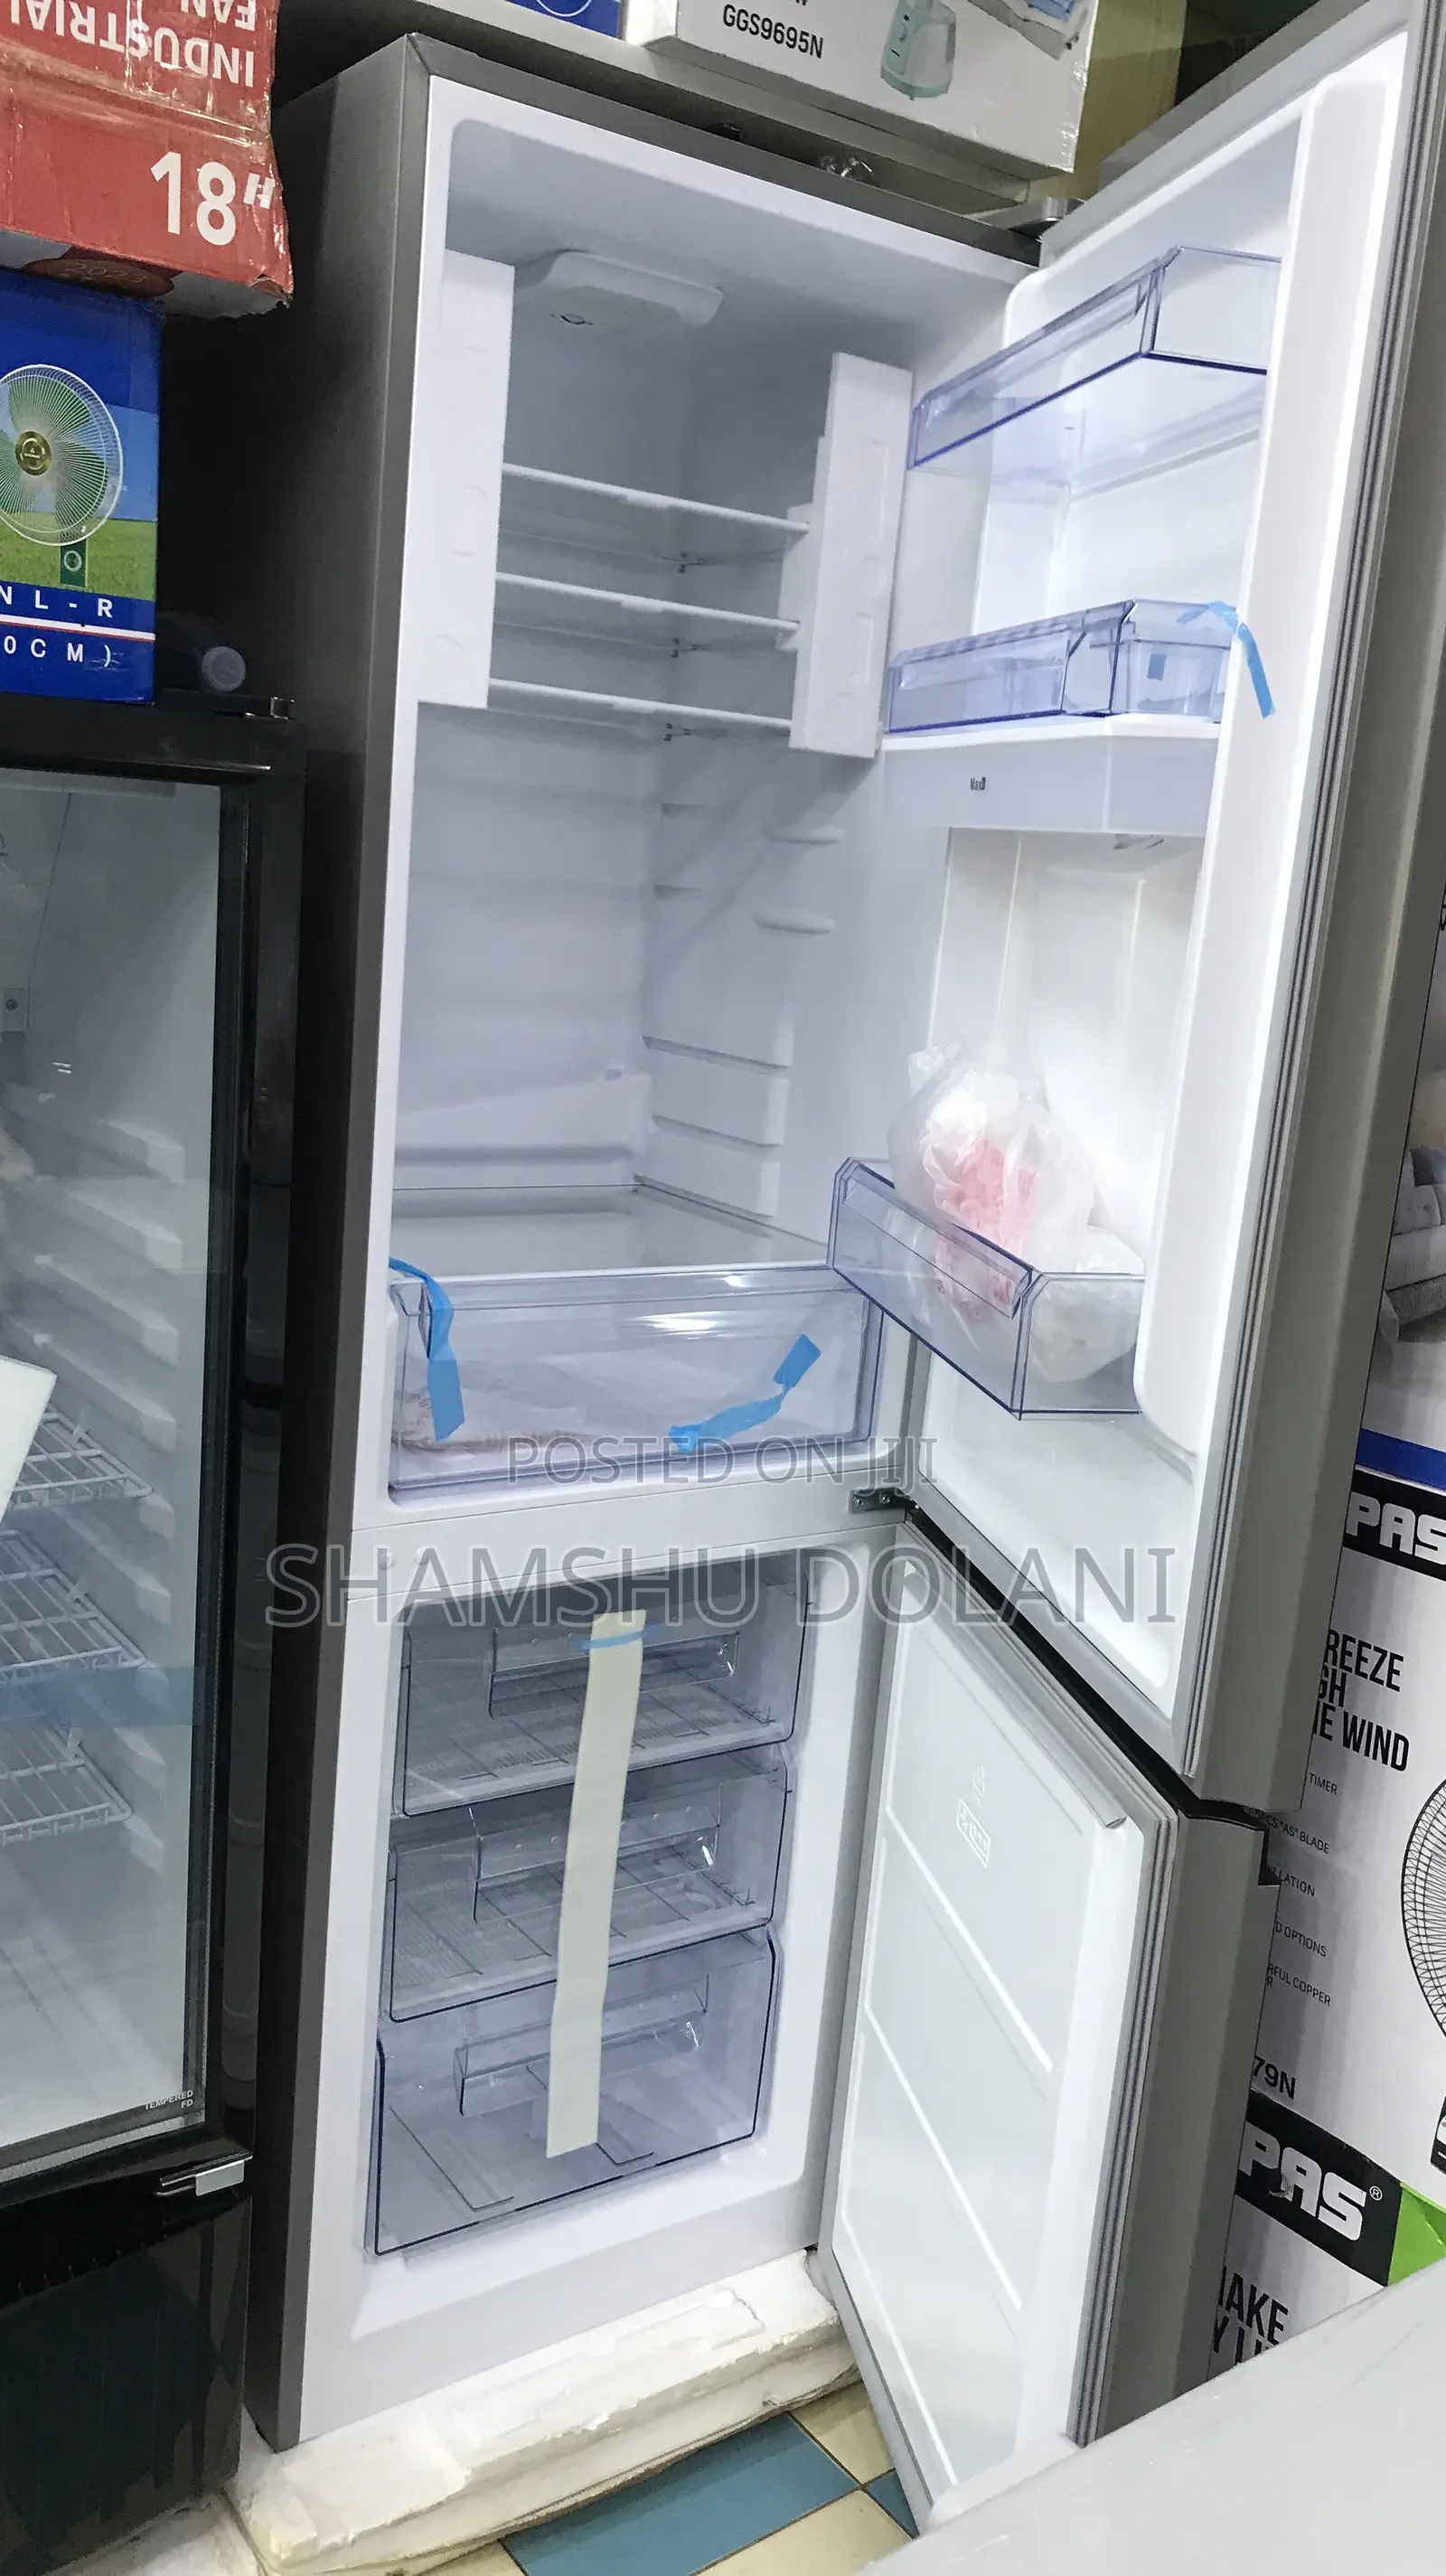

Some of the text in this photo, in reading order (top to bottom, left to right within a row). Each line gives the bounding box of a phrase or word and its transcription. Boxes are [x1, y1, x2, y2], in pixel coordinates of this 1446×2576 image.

[723, 4, 823, 59] GGS9695N
[1342, 1711, 1410, 1772] WIND
[1309, 1772, 1338, 1795] TIMER
[1300, 1831, 1329, 1854] BLADE
[1284, 1926, 1327, 1957] OPTIONS
[1293, 1977, 1331, 2007] COPPER
[145, 2090, 194, 2111] TEMPERED
[181, 2099, 193, 2109] FD
